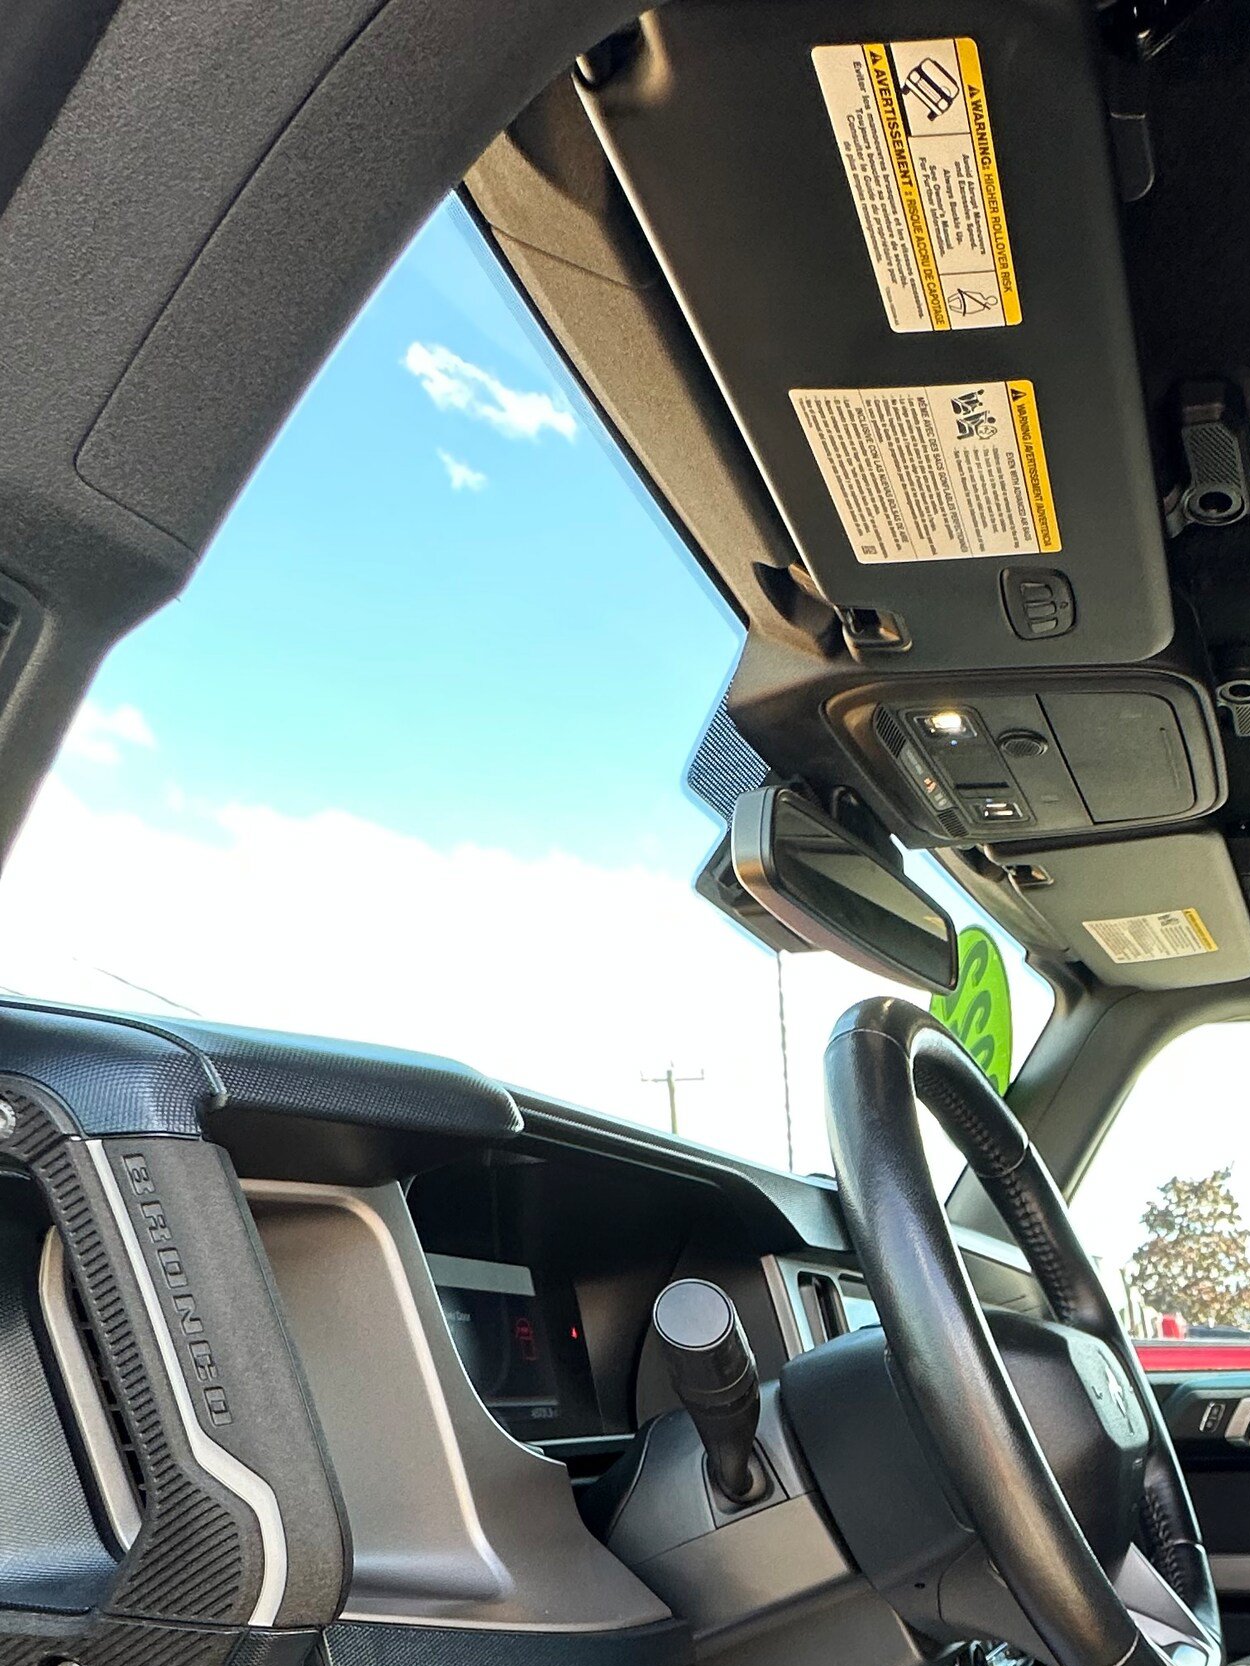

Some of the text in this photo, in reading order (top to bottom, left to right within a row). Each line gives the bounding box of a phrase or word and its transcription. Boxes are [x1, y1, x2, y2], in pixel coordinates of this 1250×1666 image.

[873, 68, 913, 187] AVERTISSEMENT
[971, 99, 1013, 293] WARNING: HIGHER ROLLOVER RISK
[907, 199, 923, 234] RISQUE
[915, 236, 930, 267] ACCRU
[924, 269, 934, 280] DE
[927, 282, 944, 325] CAPOTAGE
[1017, 404, 1031, 441] WARNING
[122, 1153, 234, 1427] BRONCO
